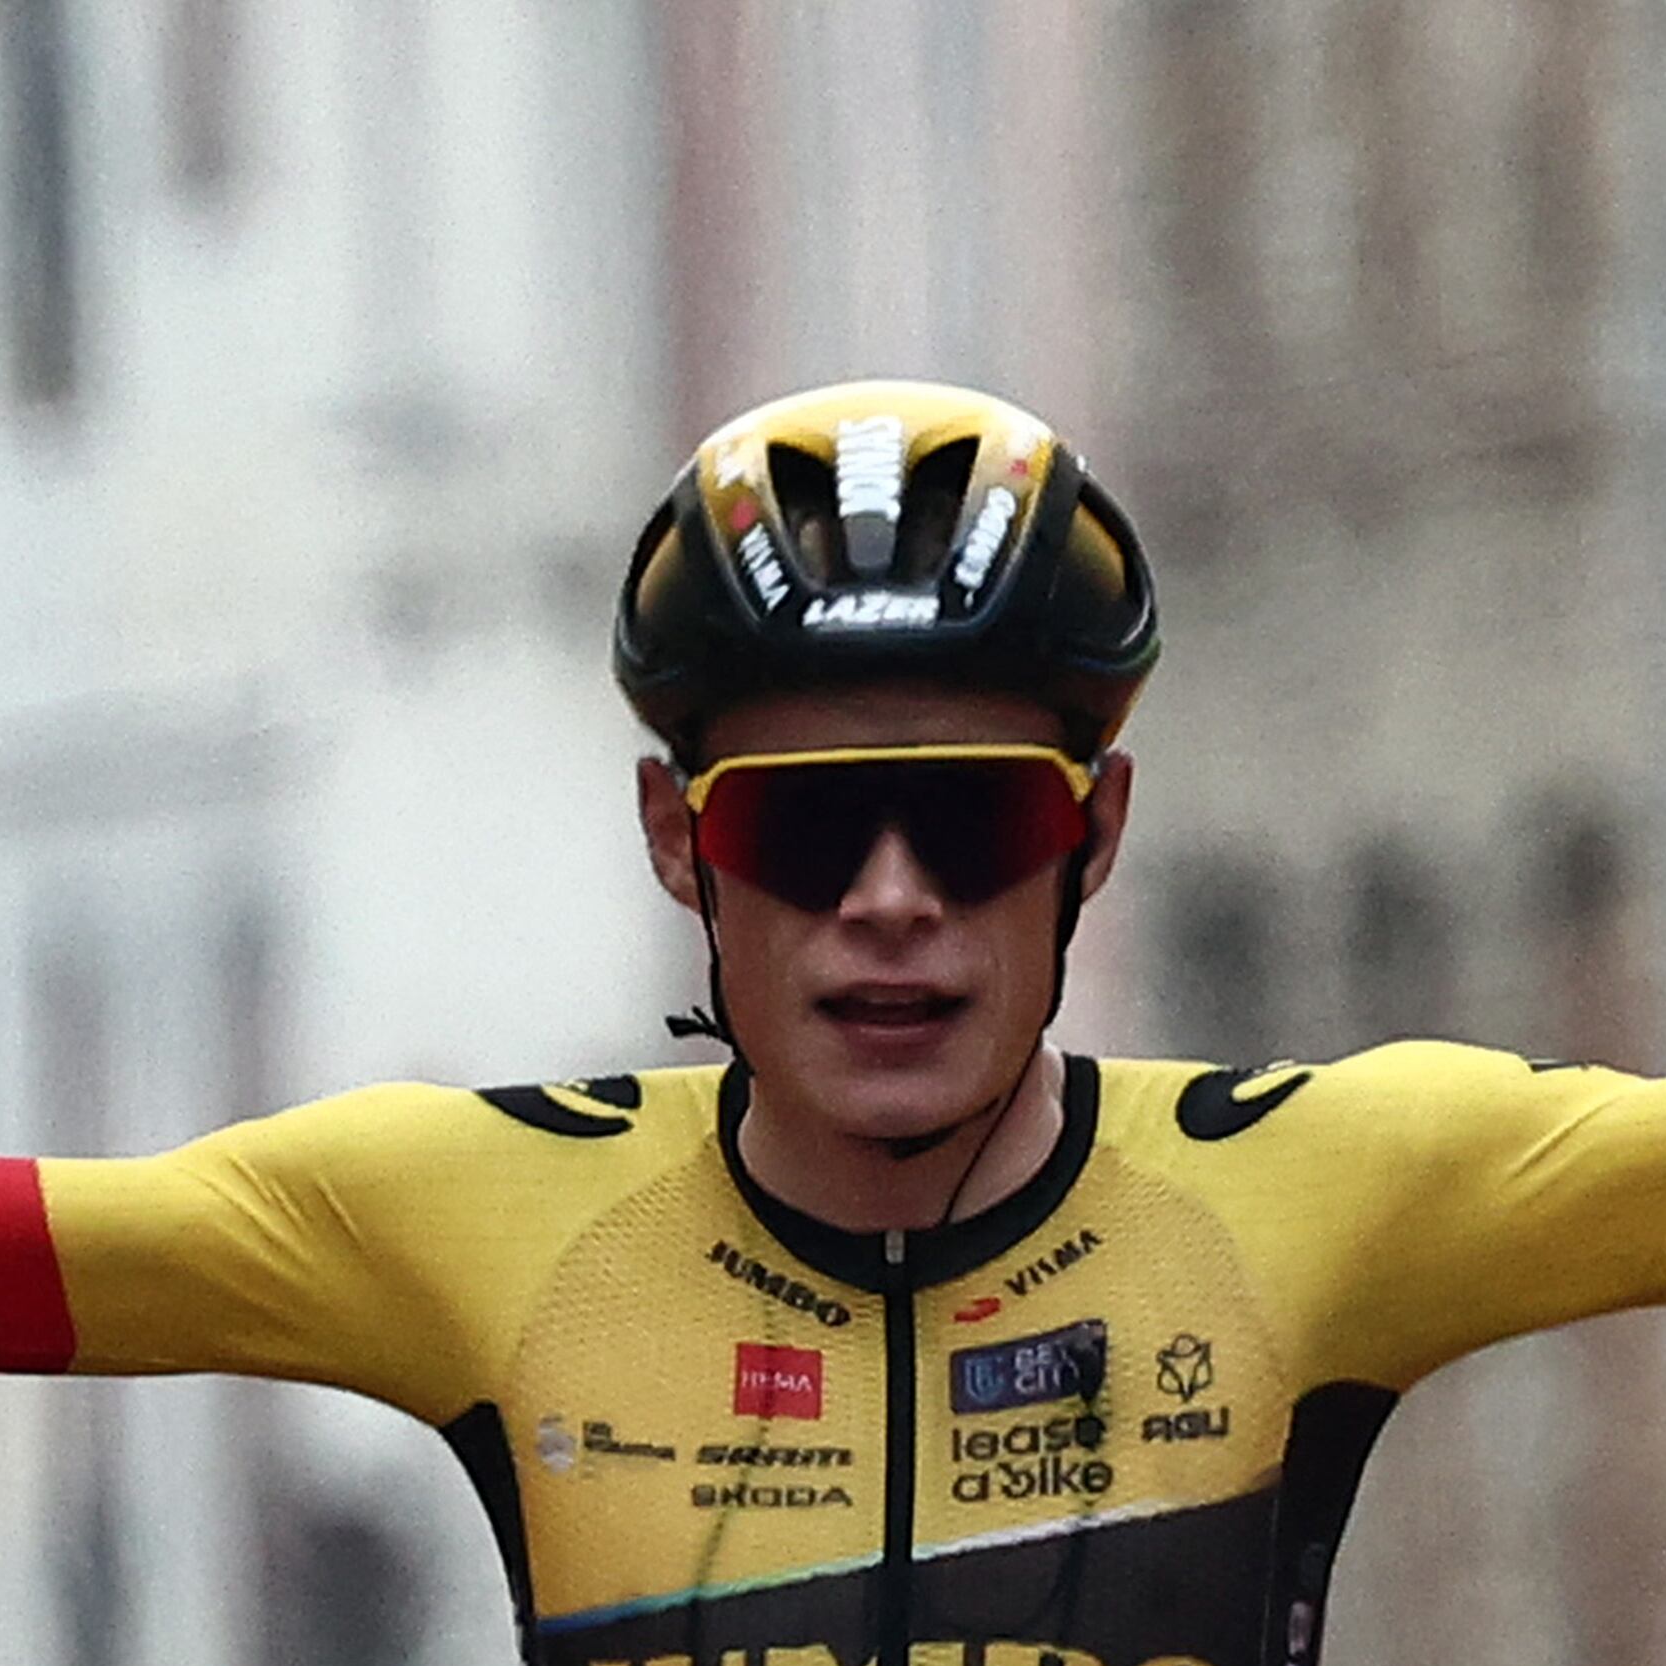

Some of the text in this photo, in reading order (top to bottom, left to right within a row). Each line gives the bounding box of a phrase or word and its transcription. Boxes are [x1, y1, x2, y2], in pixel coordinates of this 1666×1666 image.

[801, 590, 940, 630] LAZER
[704, 1239, 852, 1328] JUMBO
[1004, 1229, 1103, 1297] VISMA
[951, 1414, 1106, 1463] lease
